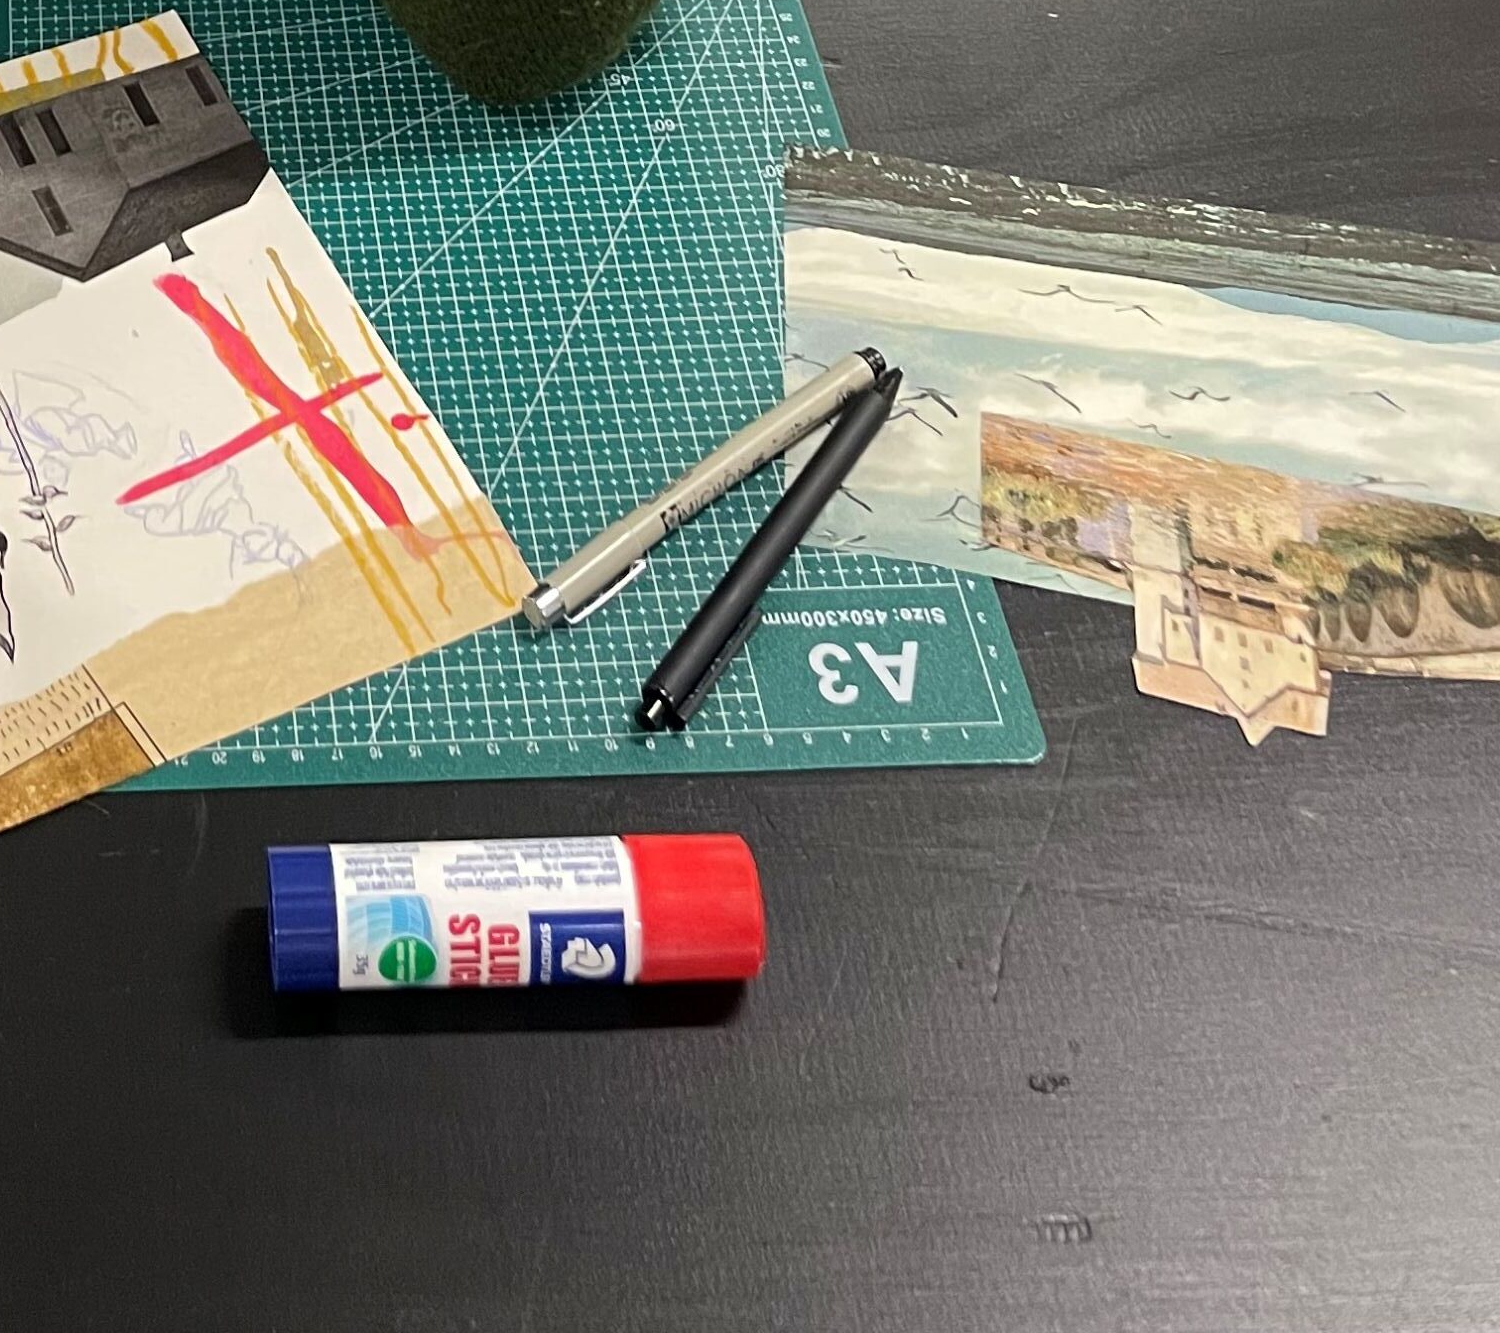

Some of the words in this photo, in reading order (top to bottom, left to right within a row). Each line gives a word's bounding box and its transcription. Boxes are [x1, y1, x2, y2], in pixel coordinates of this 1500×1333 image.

[779, 13, 792, 22] 25
[787, 35, 800, 44] 24
[794, 58, 806, 67] 23
[802, 82, 814, 90] 22
[810, 104, 823, 113] 21
[817, 128, 831, 138] 20
[761, 608, 888, 628] 450x300mm
[808, 640, 918, 704] A3
[764, 733, 773, 746] 6
[803, 731, 812, 745] 5
[842, 730, 852, 744] 4
[881, 729, 891, 743] 3
[921, 727, 930, 742] 2
[961, 727, 969, 740] 1
[527, 741, 539, 753] 12
[568, 740, 579, 751] 11
[605, 738, 619, 751] 10
[645, 737, 655, 750] 9
[685, 736, 695, 749] 8
[725, 734, 734, 748] 7
[332, 748, 344, 760] 17
[370, 746, 383, 759] 16
[409, 745, 422, 757] 15
[448, 744, 461, 756] 14
[487, 743, 500, 754] 13
[213, 752, 227, 764] 20
[253, 750, 265, 763] 19
[292, 749, 304, 762] 18
